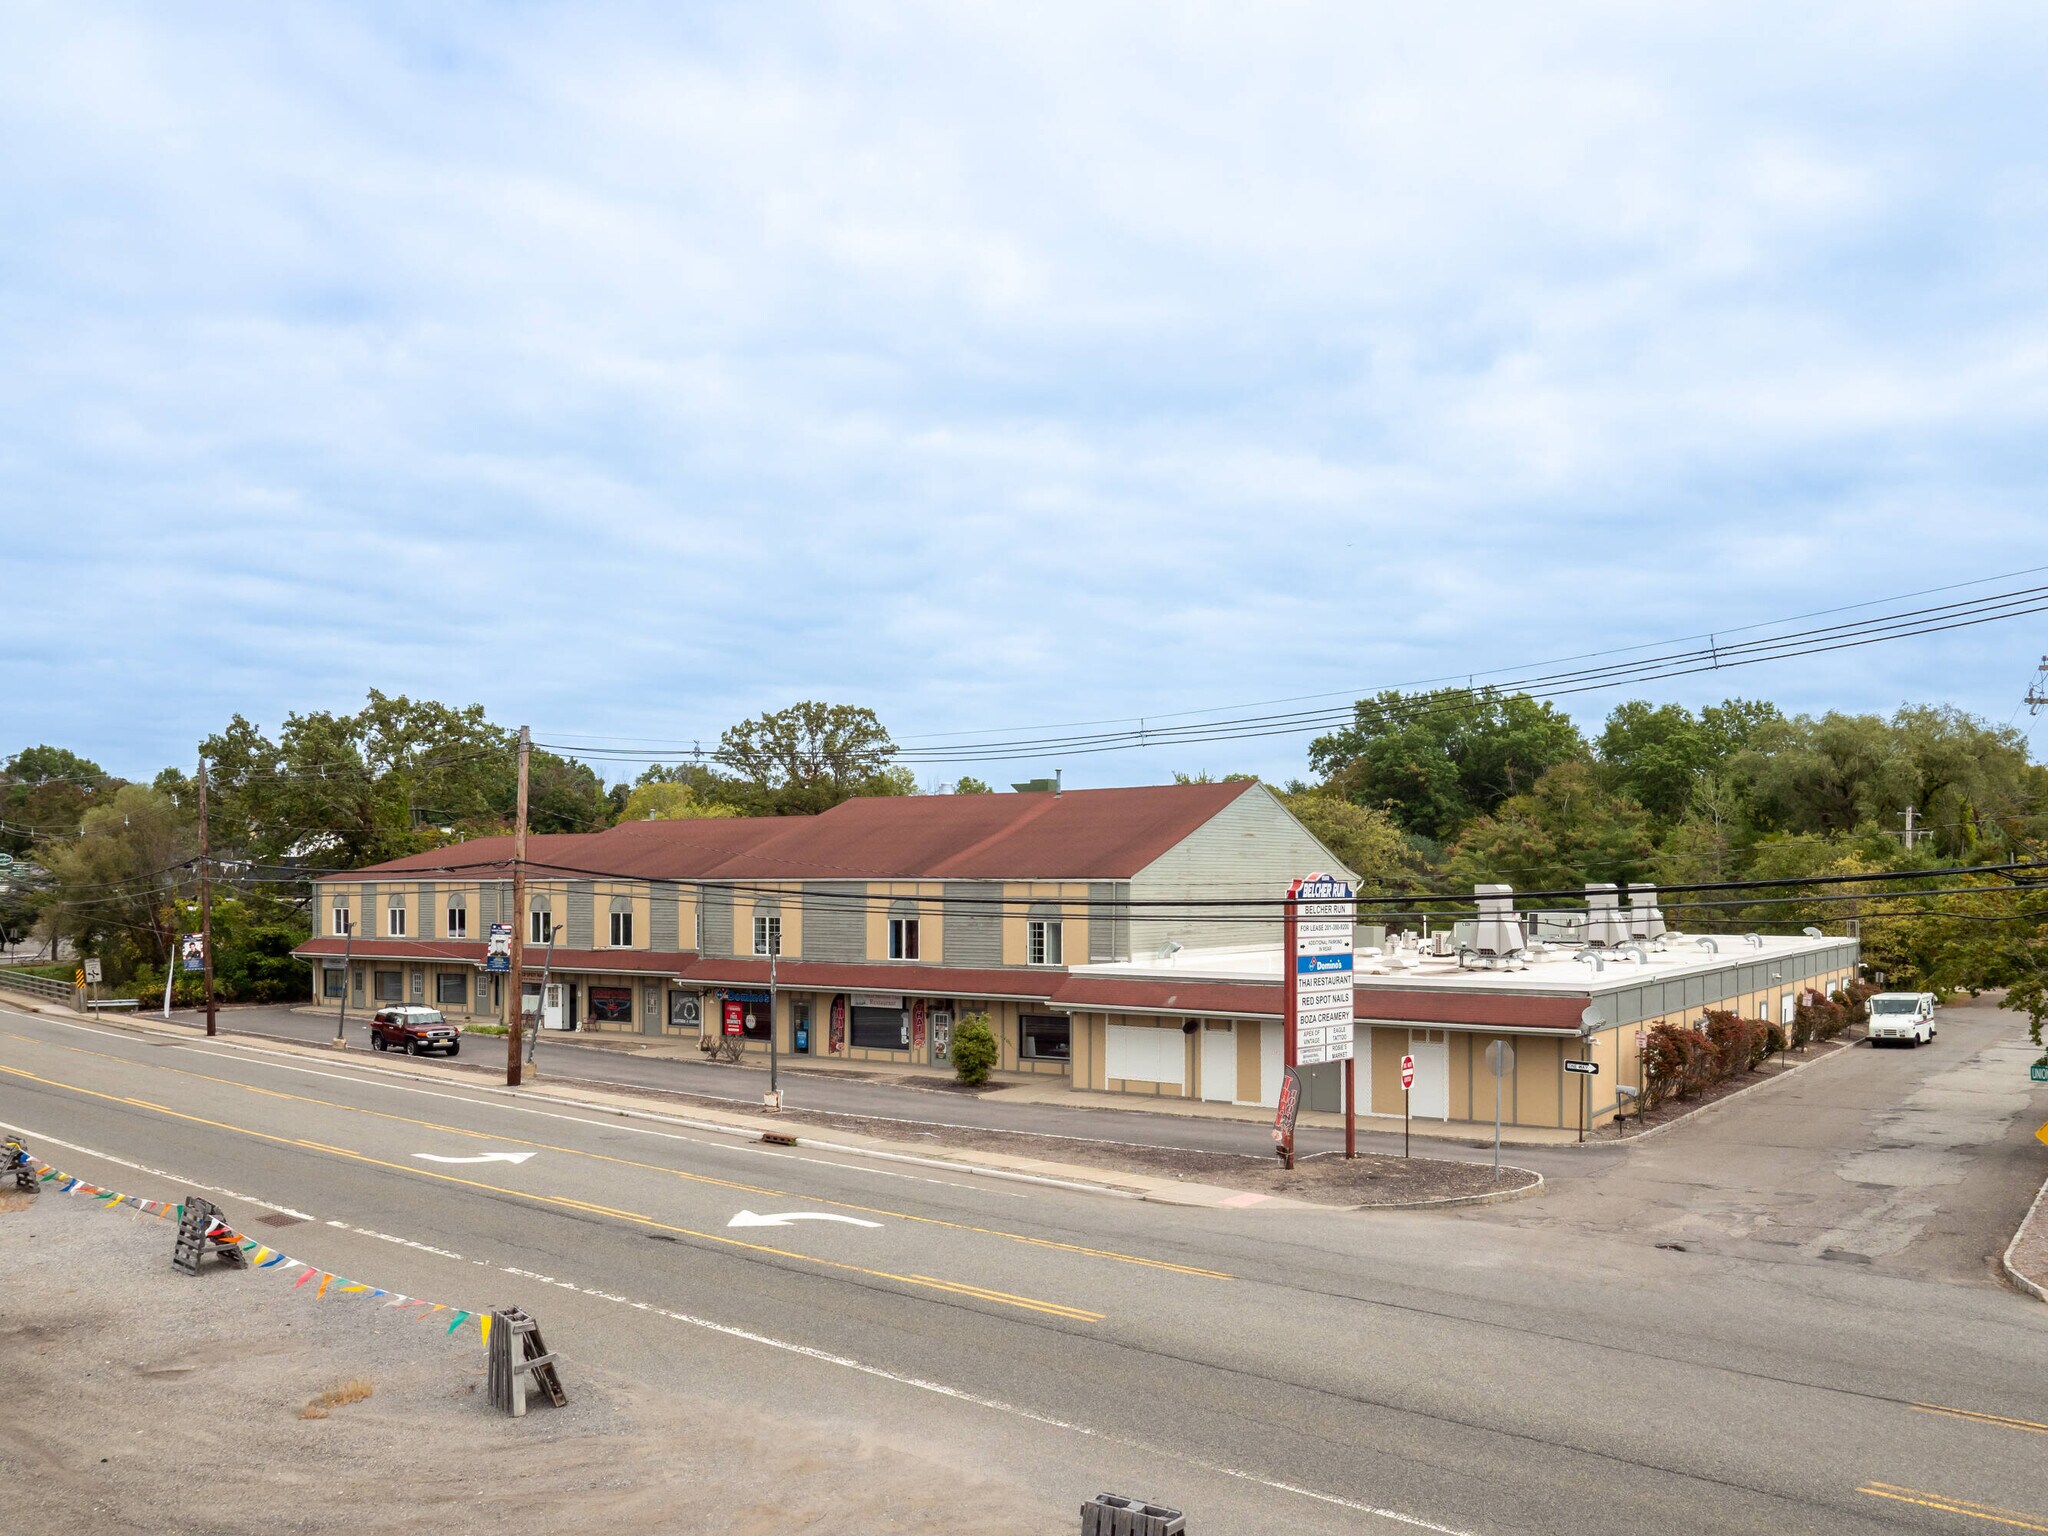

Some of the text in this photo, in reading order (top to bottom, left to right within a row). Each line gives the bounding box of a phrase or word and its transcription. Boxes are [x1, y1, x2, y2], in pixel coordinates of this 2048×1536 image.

[1302, 883, 1346, 898] BELCHER RUN
[1304, 905, 1346, 914] BELCHER RUN
[1310, 924, 1324, 932] LEASE
[1316, 959, 1342, 970] Domino's
[1299, 975, 1351, 987] THAI RESTAURANT
[727, 990, 771, 1003] Domino's
[1301, 993, 1349, 1006] RED SPOT NAILS
[1300, 1011, 1350, 1024] BOZA CREAMERY
[1332, 1051, 1348, 1059] MARKET
[1275, 1075, 1294, 1127] THAI
